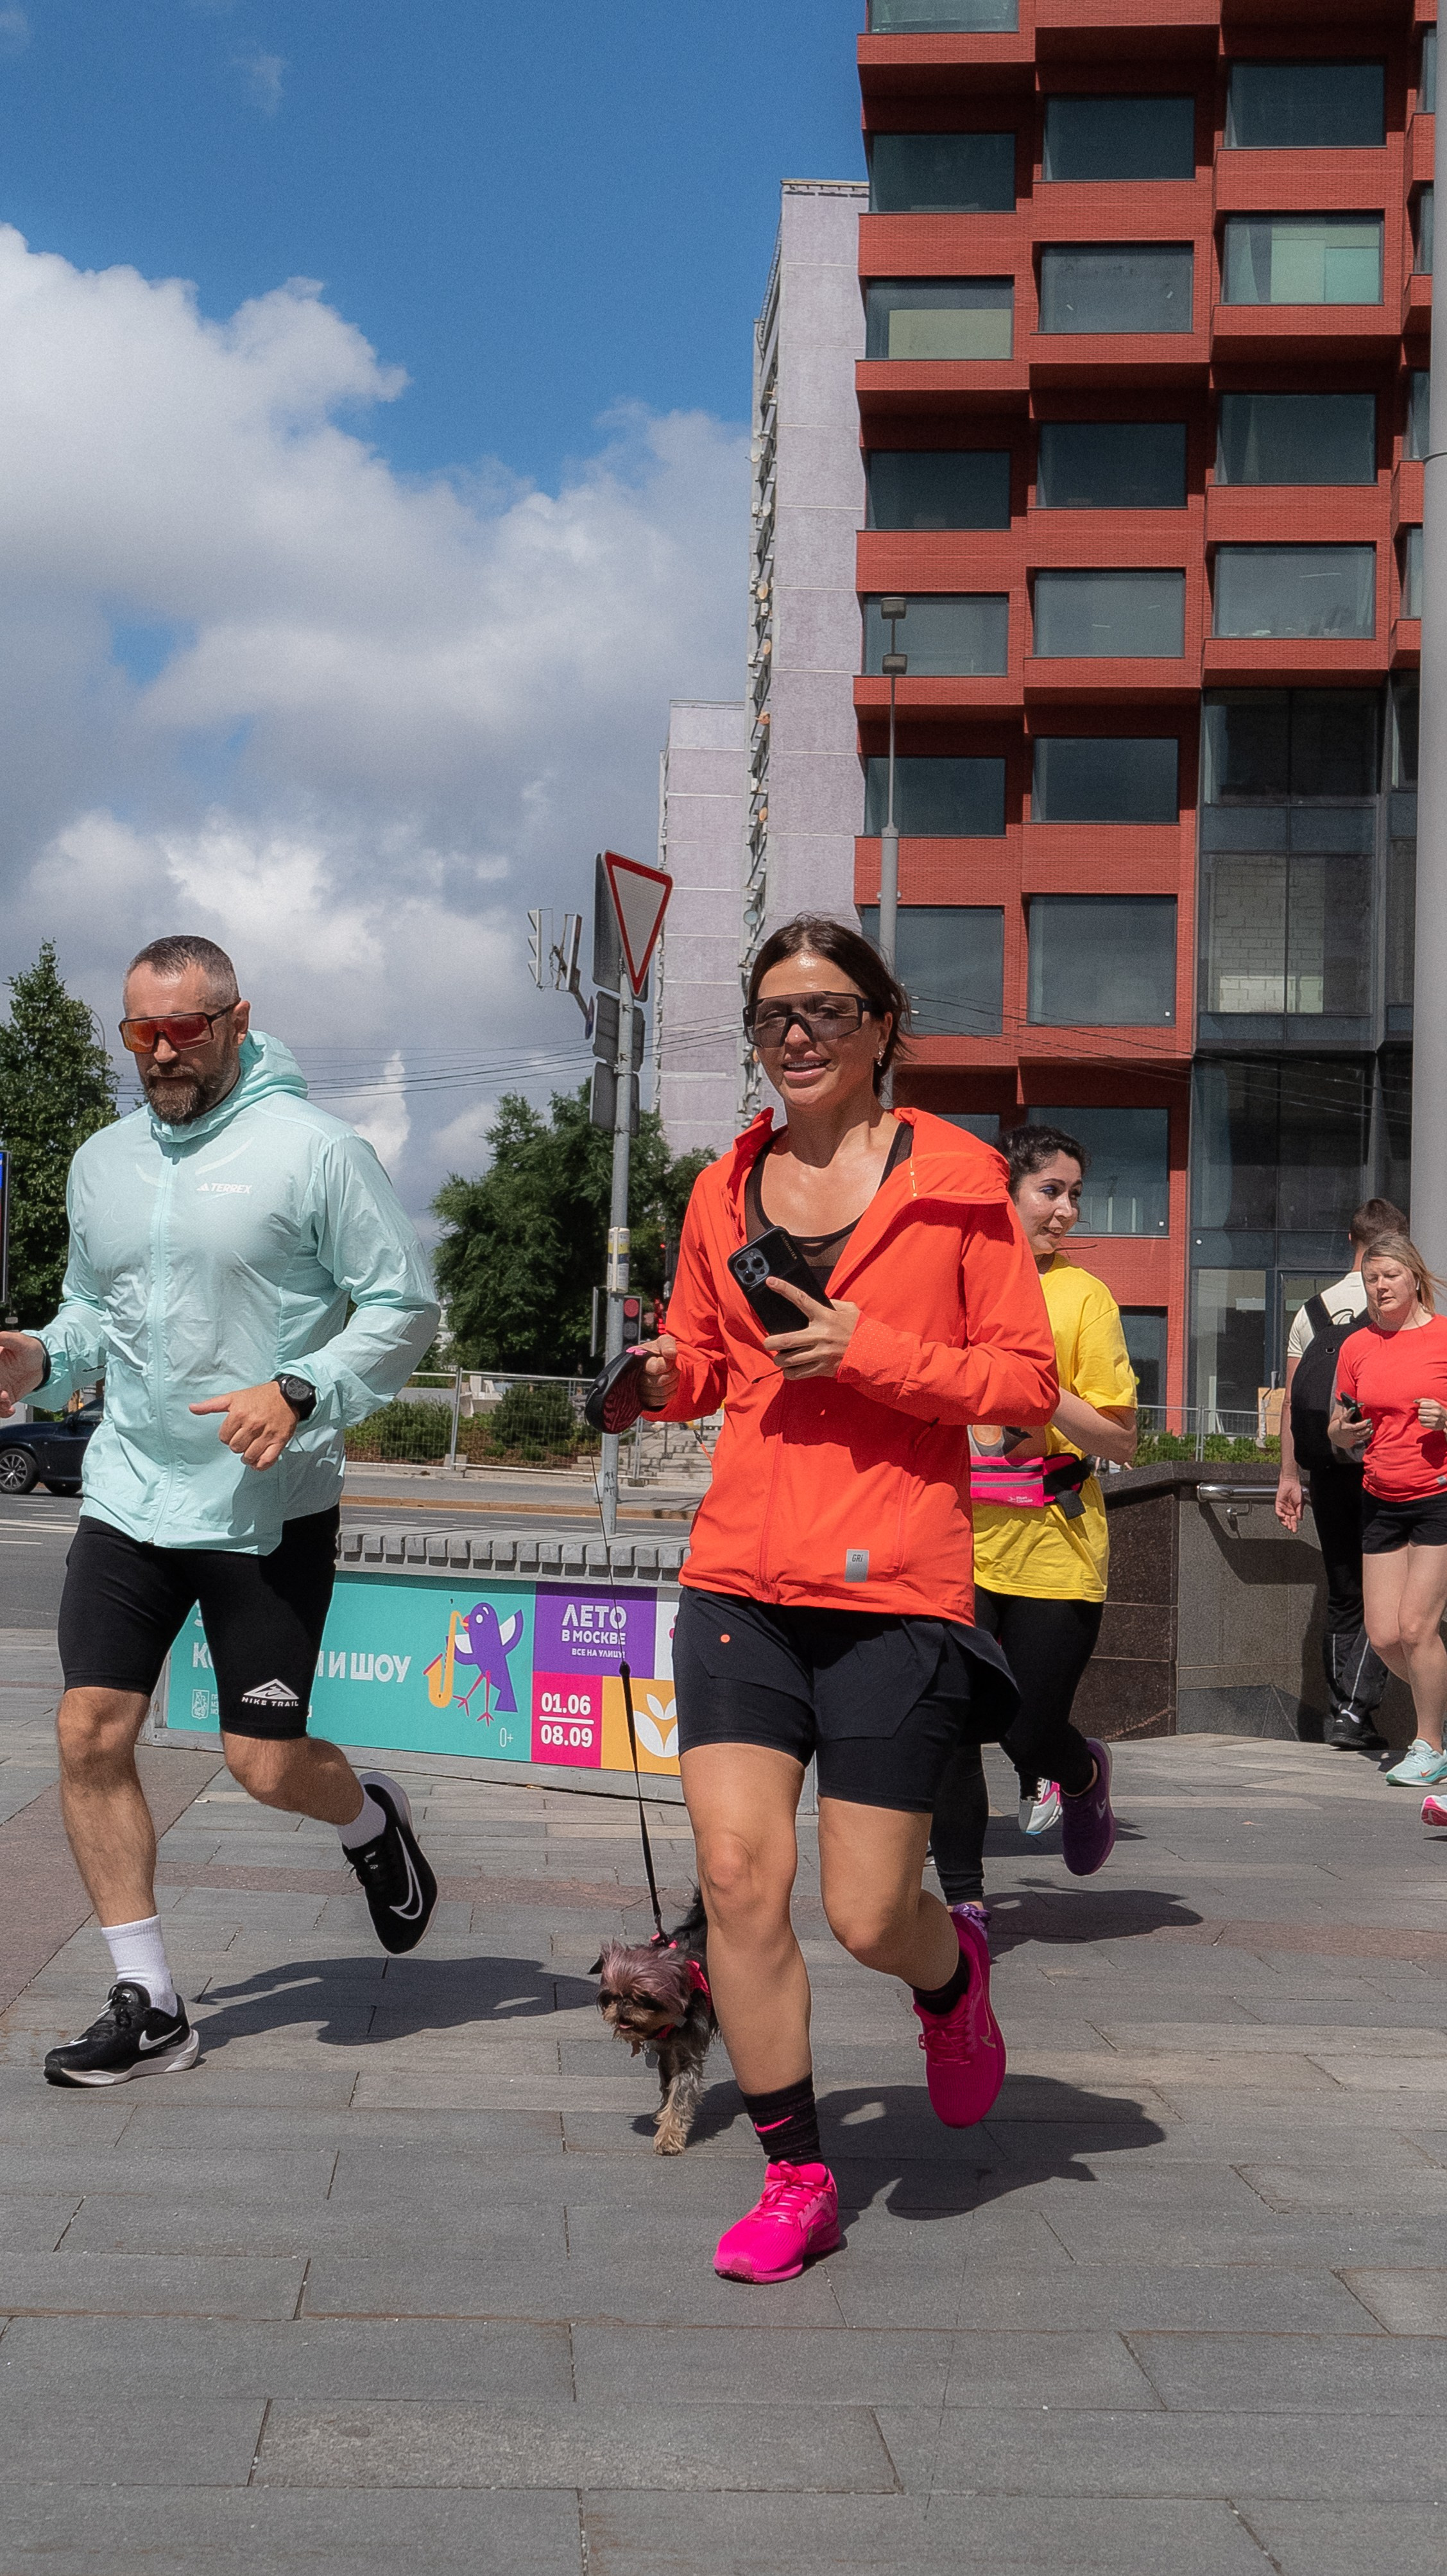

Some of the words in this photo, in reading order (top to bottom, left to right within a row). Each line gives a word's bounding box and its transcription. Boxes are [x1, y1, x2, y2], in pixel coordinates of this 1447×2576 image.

[210, 1182, 252, 1194] TERREX
[562, 1604, 627, 1629] ЛЕТО
[562, 1630, 570, 1642] В
[572, 1630, 626, 1645] МОСКВЕ
[350, 1653, 412, 1683] ШОУ
[241, 1696, 268, 1706] NIKE
[541, 1692, 591, 1715] 01.06
[499, 1727, 513, 1747] 0+
[540, 1724, 593, 1747] 08.09
